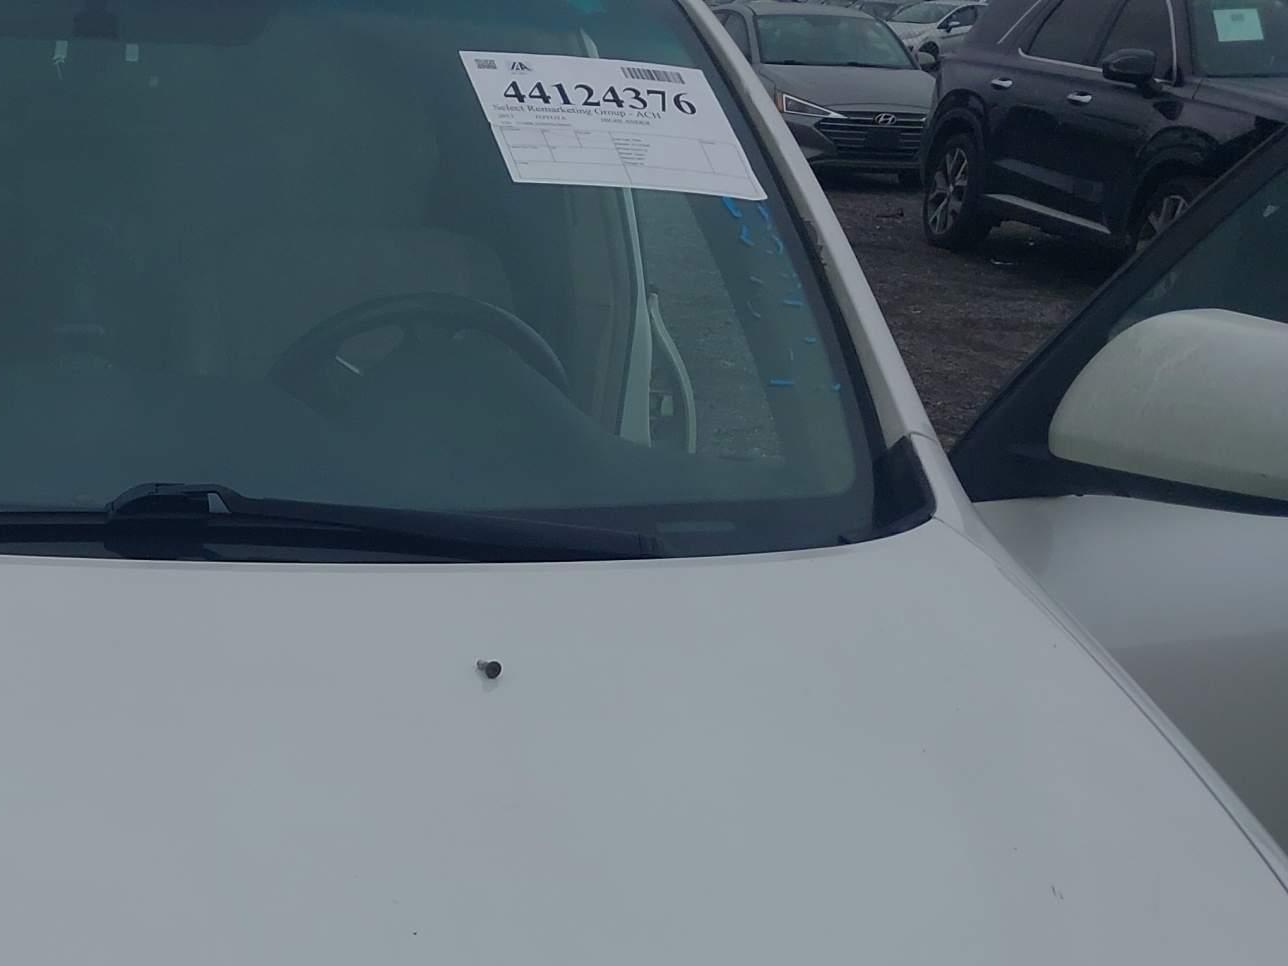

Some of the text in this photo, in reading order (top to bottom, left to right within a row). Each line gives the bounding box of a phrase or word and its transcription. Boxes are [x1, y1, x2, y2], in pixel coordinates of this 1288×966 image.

[503, 80, 697, 116] 44124376
[492, 104, 524, 112] Select
[527, 105, 592, 117] Remarketing
[594, 108, 626, 118] Group
[636, 111, 662, 120] ACH
